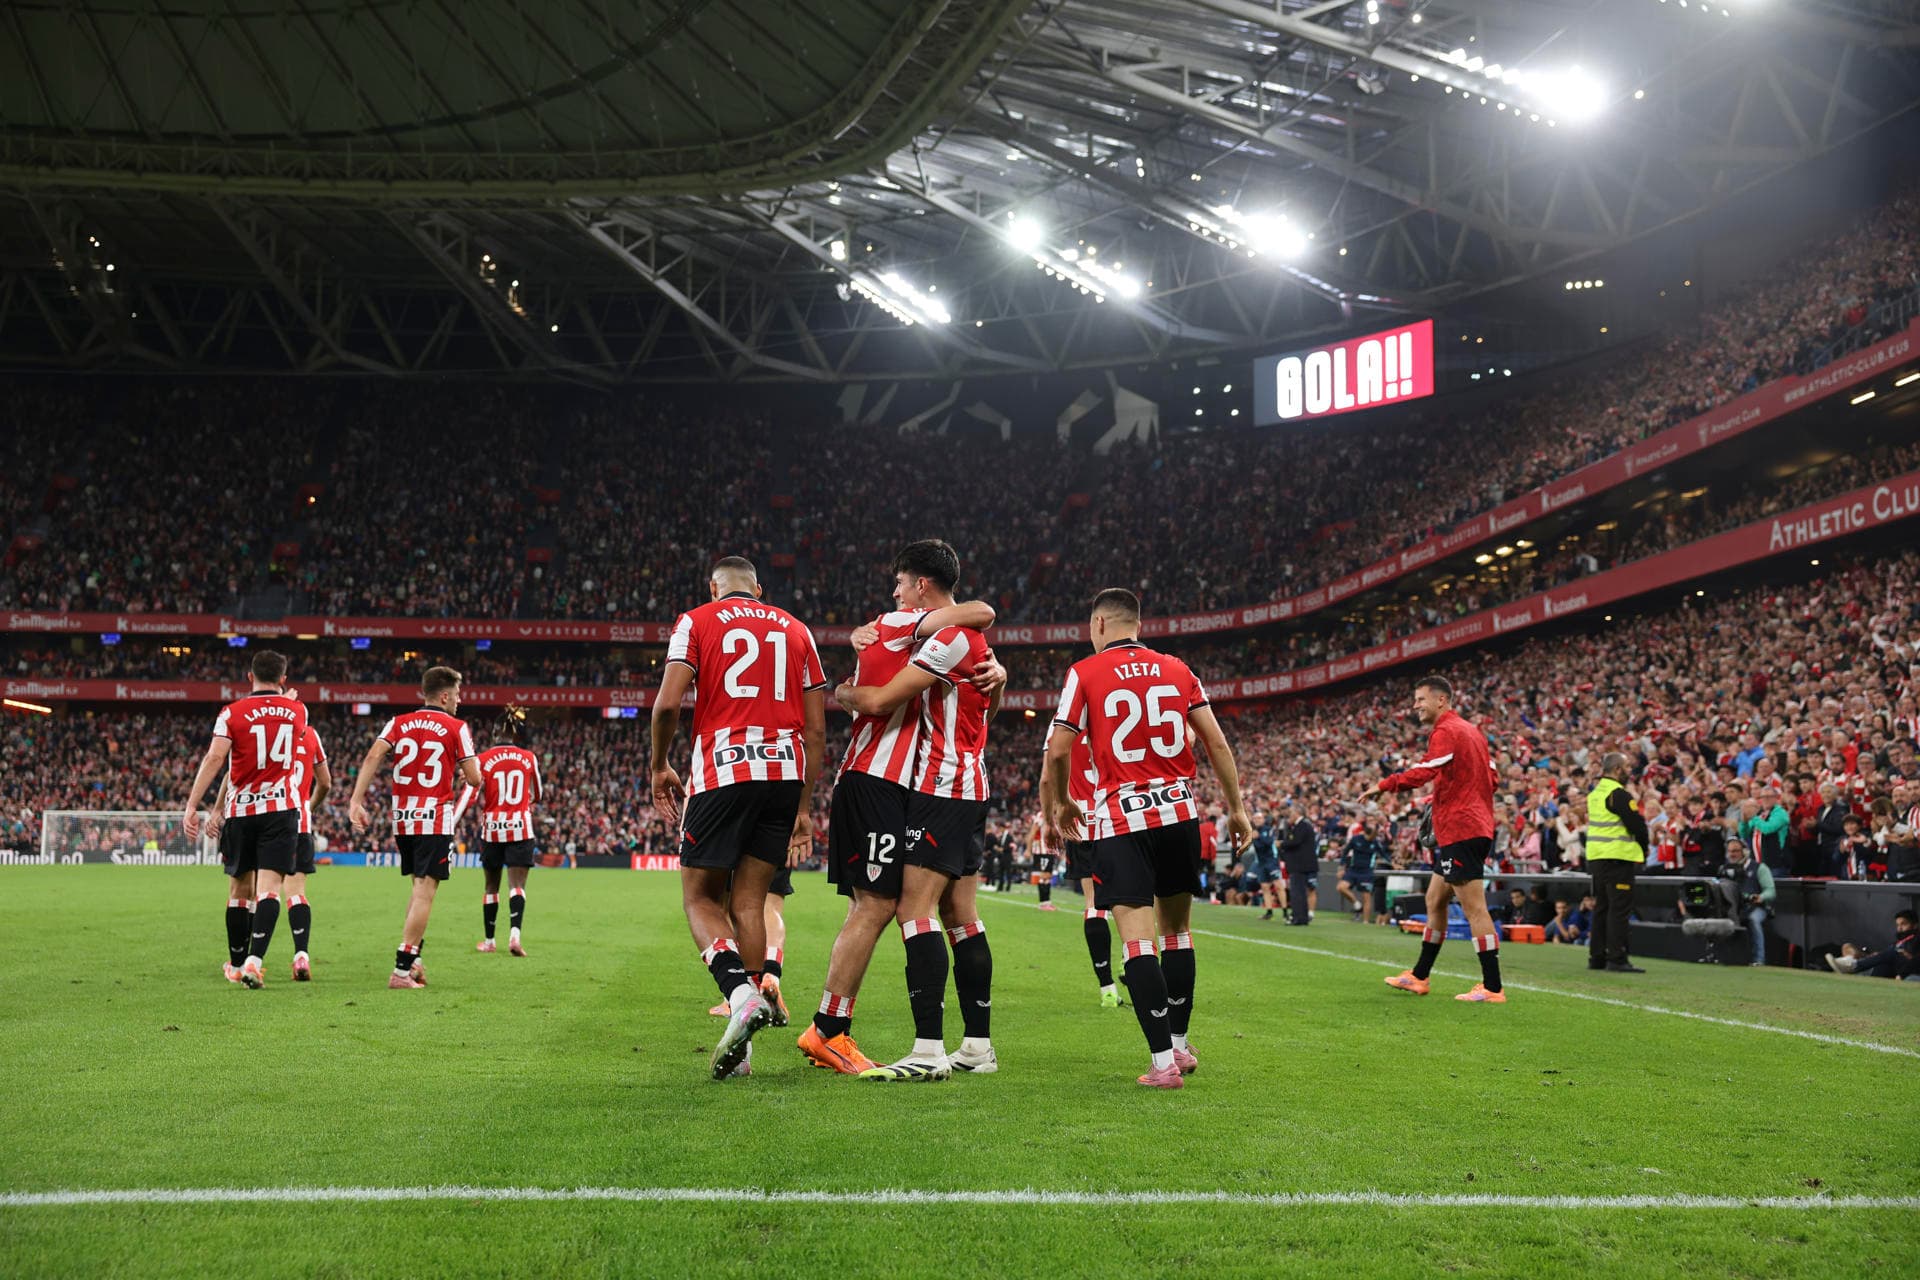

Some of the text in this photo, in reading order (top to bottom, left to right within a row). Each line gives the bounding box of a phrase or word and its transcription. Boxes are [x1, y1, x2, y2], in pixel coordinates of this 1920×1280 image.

[716, 606, 790, 628] MAROAN
[997, 628, 1034, 643] IMQ
[1046, 626, 1080, 641] IMQ
[722, 628, 787, 702] 21
[1114, 662, 1161, 680] IZETA
[244, 706, 296, 722] LAPORTE
[1104, 685, 1185, 763] 25
[400, 719, 448, 737] NAVARRO
[249, 724, 294, 770] 14
[714, 744, 795, 768] DIGI
[393, 737, 445, 788] 23
[484, 752, 522, 772] WILLIAMS
[493, 770, 524, 806] 10
[1120, 781, 1193, 814] DIGI
[867, 832, 896, 863] 12
